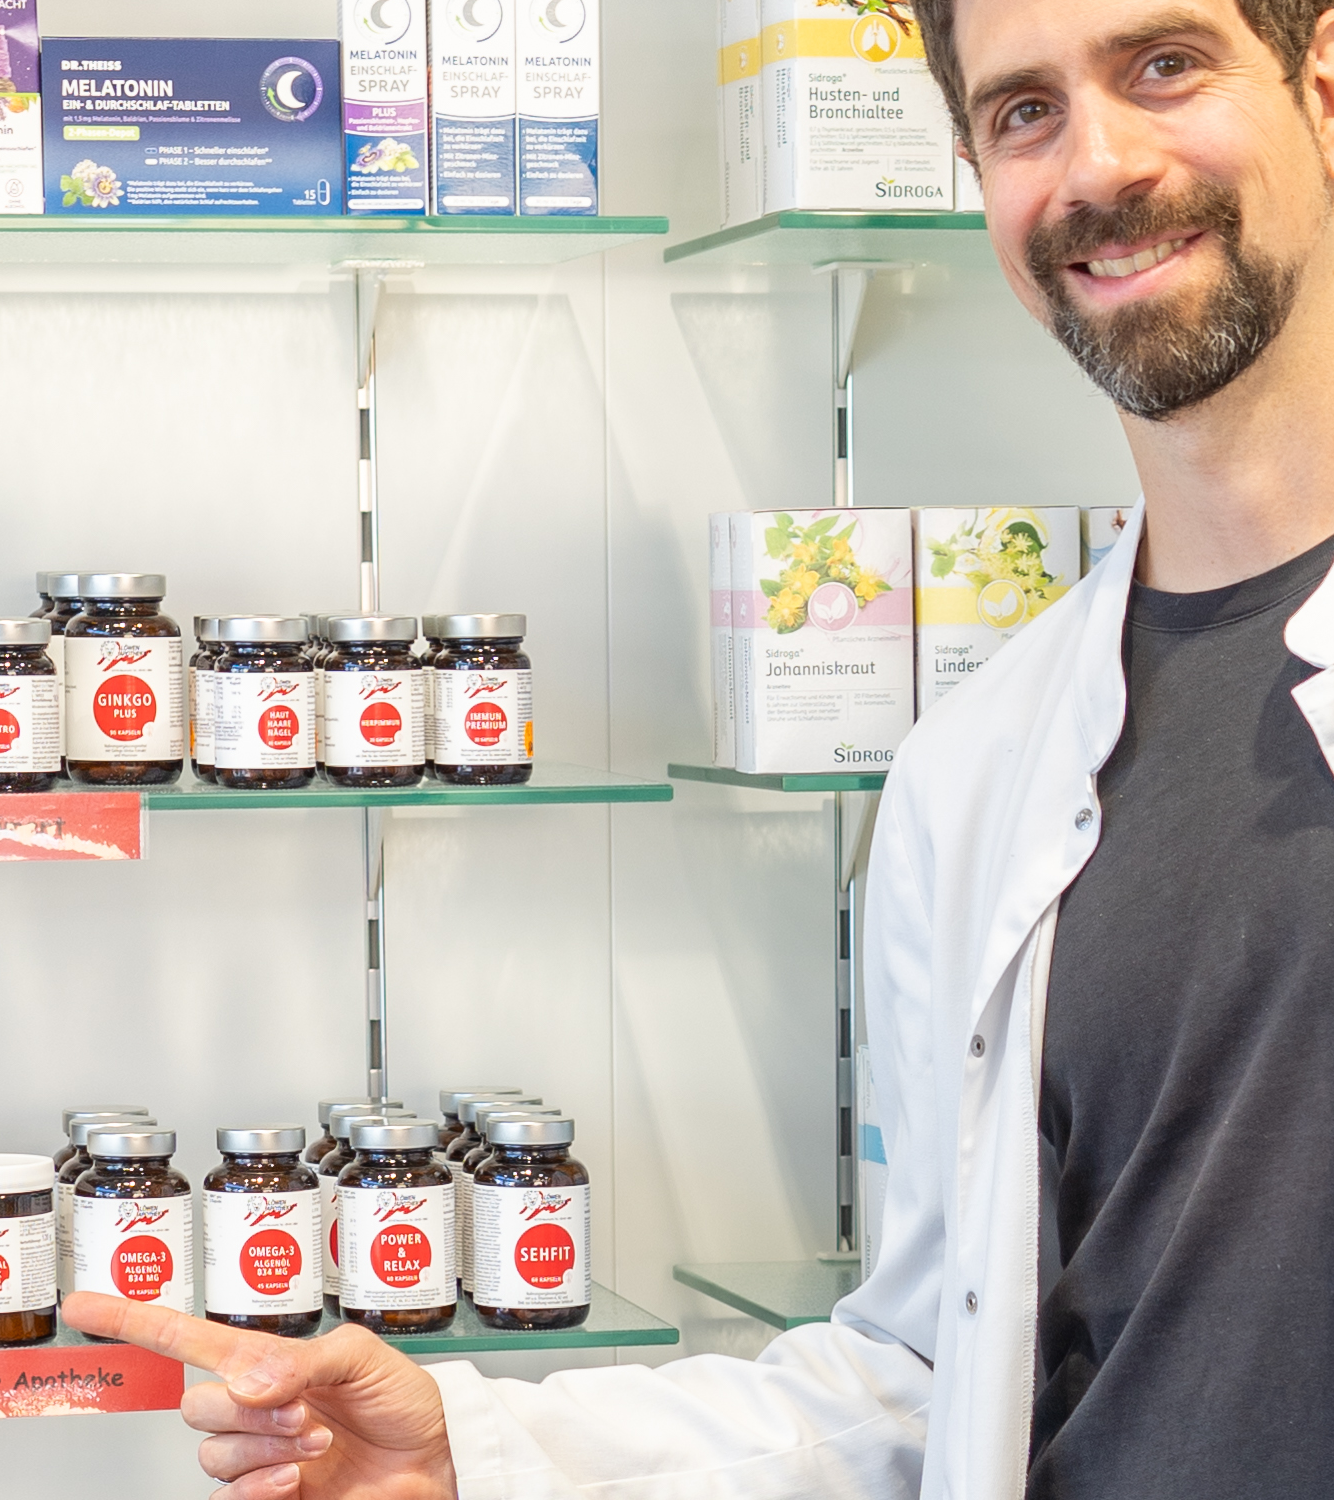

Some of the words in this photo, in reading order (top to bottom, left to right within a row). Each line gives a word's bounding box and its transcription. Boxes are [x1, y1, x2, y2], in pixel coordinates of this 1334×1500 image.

[350, 50, 417, 60] MELATONIN
[61, 60, 121, 71] DR.THEISS
[350, 65, 417, 77] EINSCHLAF-
[62, 80, 173, 96] MELATONIN
[358, 79, 410, 94] SPRAY
[809, 88, 867, 101] Husten-
[873, 88, 900, 101] und
[810, 105, 903, 120] Bronchialtee
[875, 181, 943, 198] SIDROGA
[766, 661, 875, 677] Johanniskraut
[97, 693, 152, 707] GINKGO
[113, 709, 137, 718] PLUS
[380, 1234, 421, 1245] POWER
[120, 1252, 166, 1264] OMEGA-3
[398, 1248, 406, 1258] &
[520, 1245, 570, 1262] SEHFIT
[384, 1259, 420, 1272] RELAX
